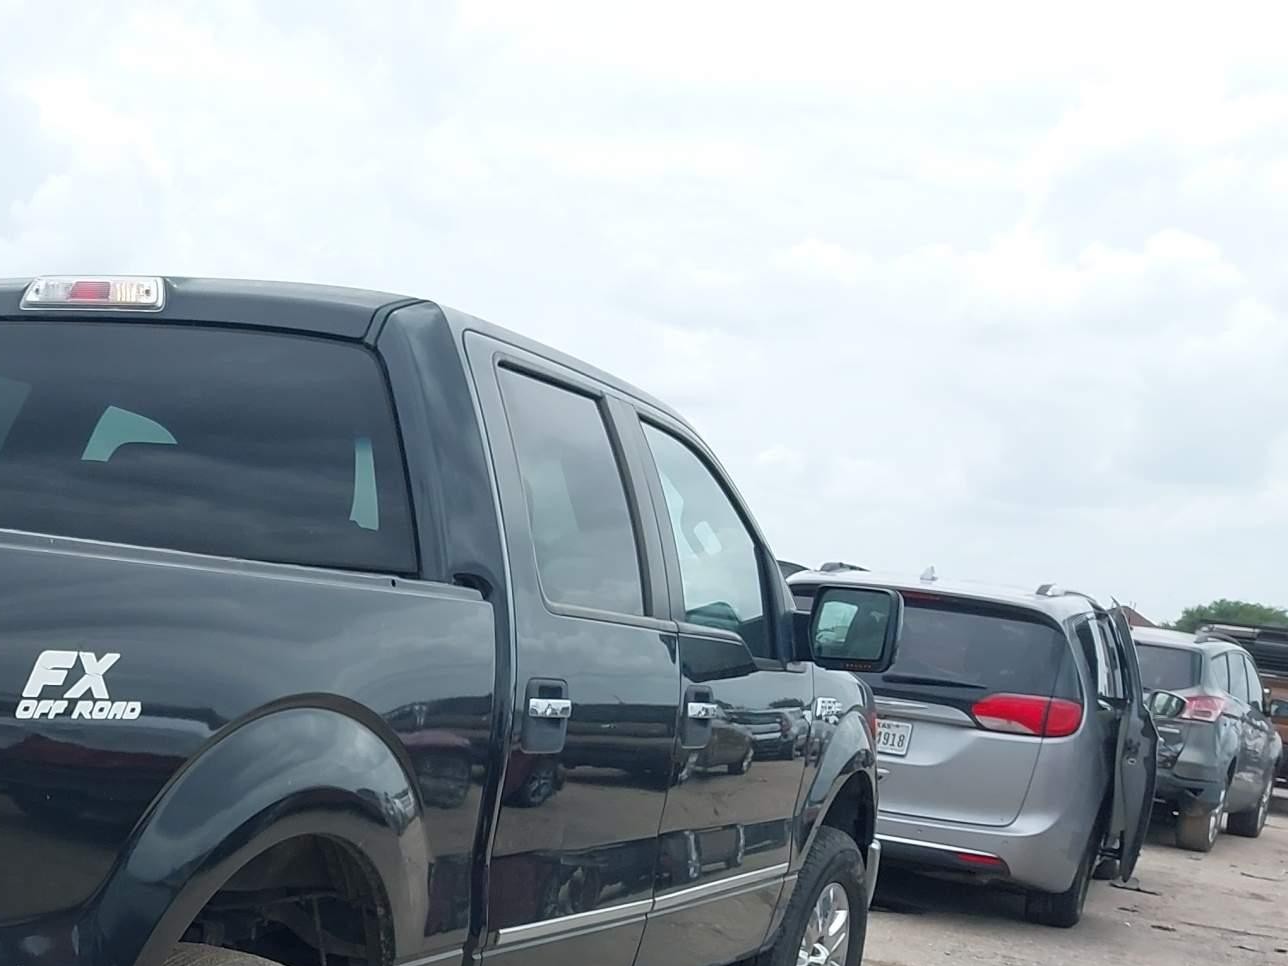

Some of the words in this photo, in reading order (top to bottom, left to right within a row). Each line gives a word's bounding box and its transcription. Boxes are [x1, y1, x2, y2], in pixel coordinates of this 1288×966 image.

[22, 650, 121, 699] FX
[15, 700, 69, 719] OFF
[71, 700, 142, 720] ROAD
